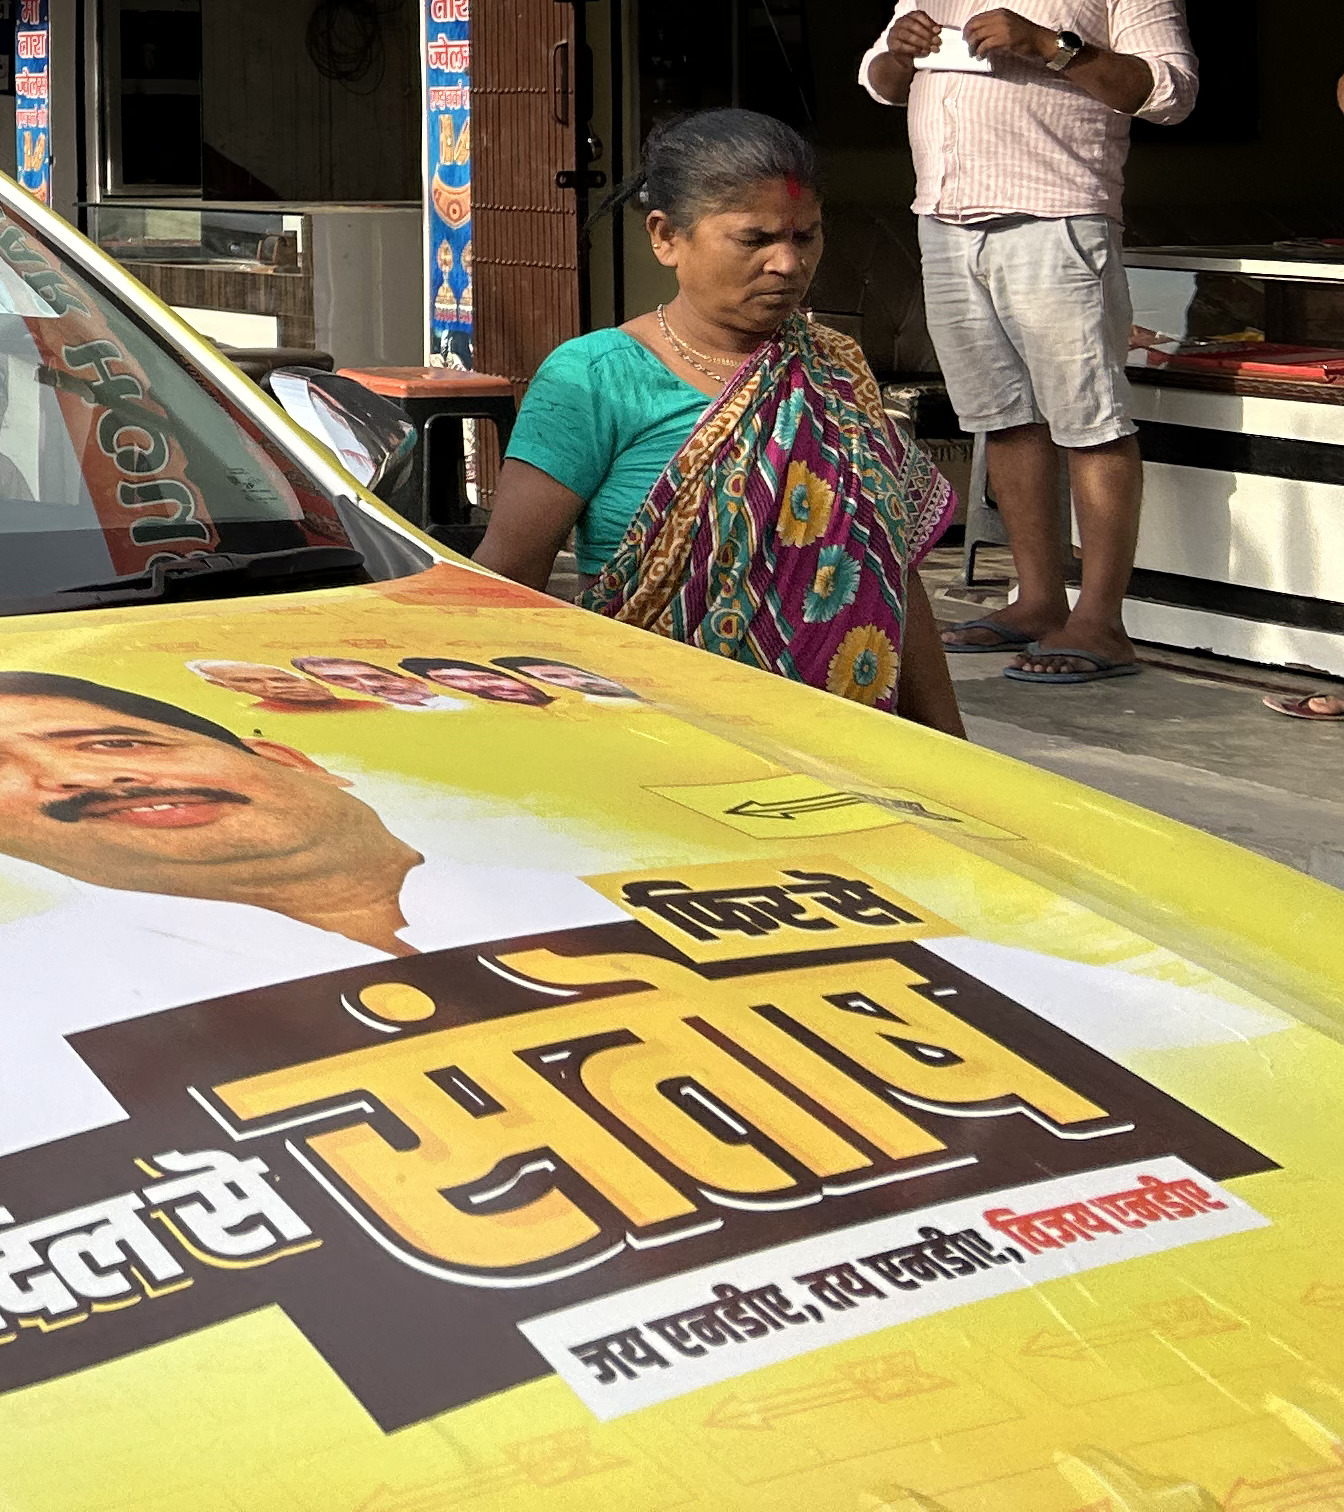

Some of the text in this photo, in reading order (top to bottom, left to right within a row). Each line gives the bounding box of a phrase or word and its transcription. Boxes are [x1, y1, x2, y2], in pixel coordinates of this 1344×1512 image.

[17, 30, 47, 59] तारा
[618, 868, 927, 943] फिर से
[194, 948, 1122, 1278] संतोष
[152, 1148, 319, 1266] से
[569, 1174, 1229, 1386] जय एनडीए, तय एनडीए, विजय एनडीए
